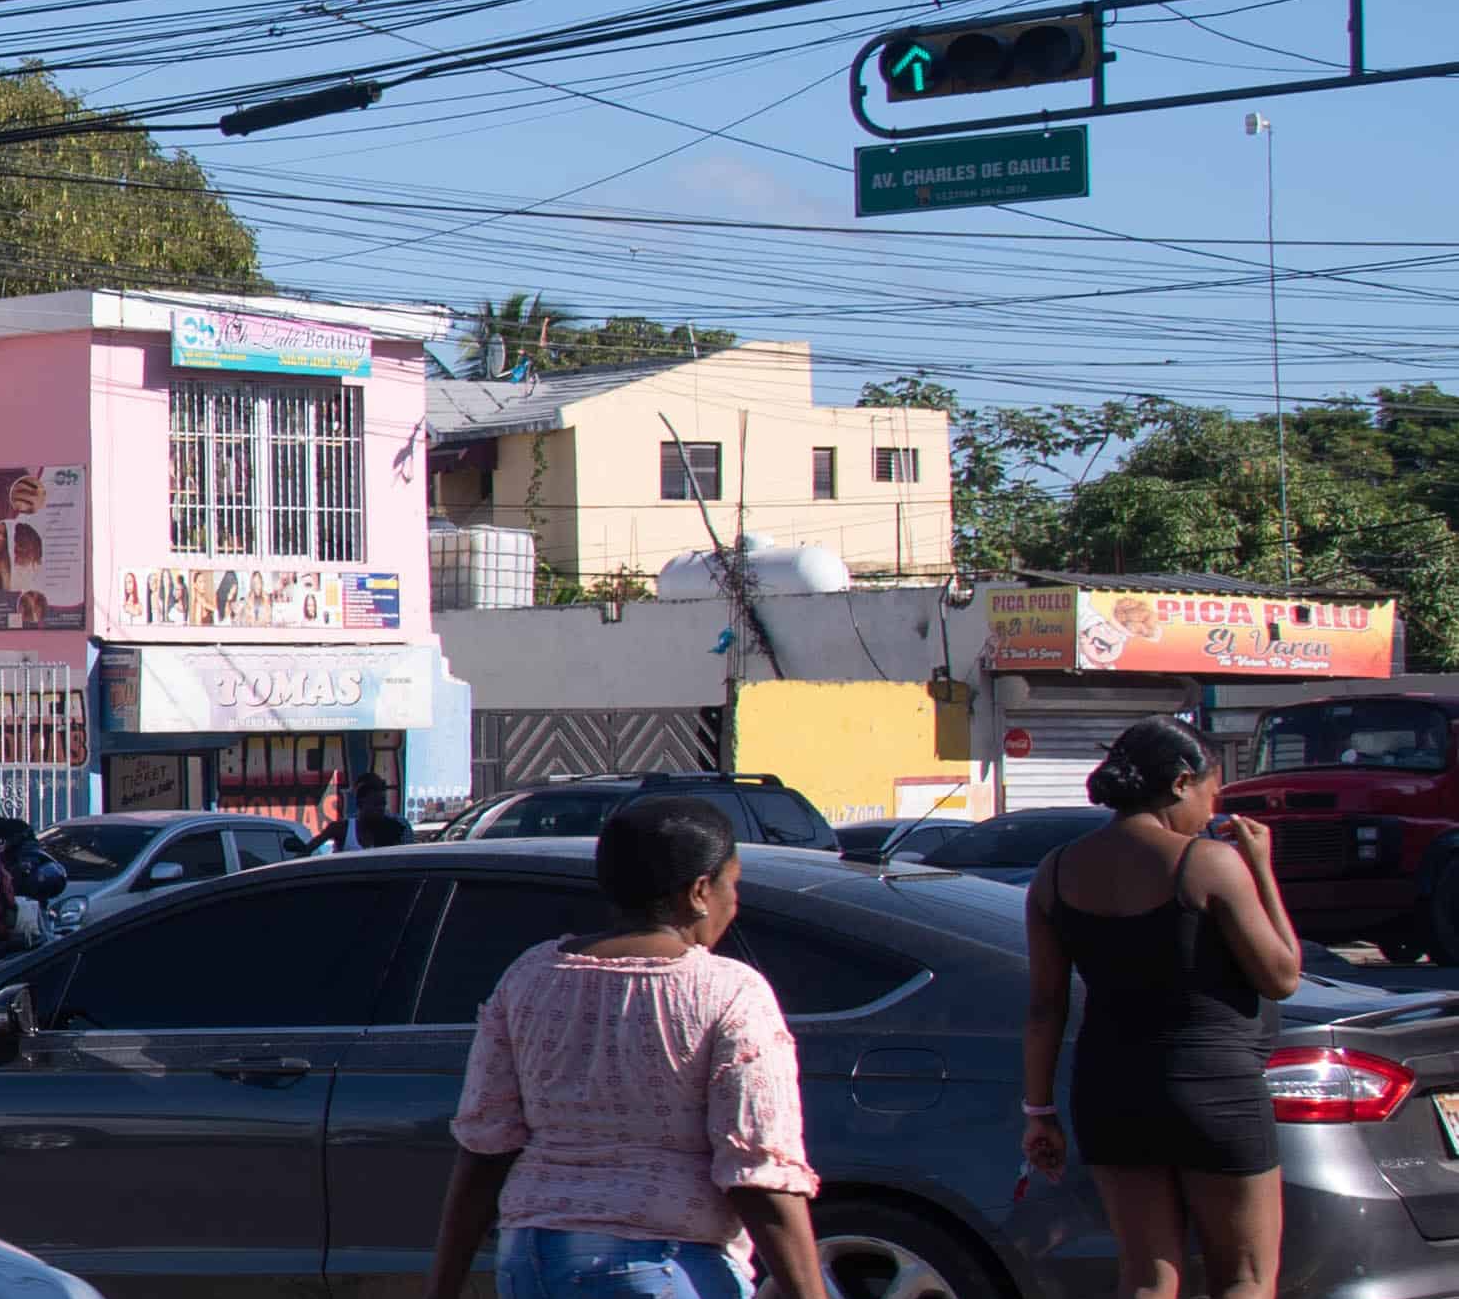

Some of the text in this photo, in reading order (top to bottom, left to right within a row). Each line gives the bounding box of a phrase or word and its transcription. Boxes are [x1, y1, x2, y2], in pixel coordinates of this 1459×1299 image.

[872, 155, 1071, 190] AV. CHARLES DE GAULLE
[303, 327, 367, 357] Beauty
[993, 592, 1071, 613] PICA POLLO
[1157, 599, 1370, 630] PICA POLLO
[1205, 628, 1235, 656] El
[217, 667, 364, 708] TOMAS
[219, 733, 349, 788] BANCA
